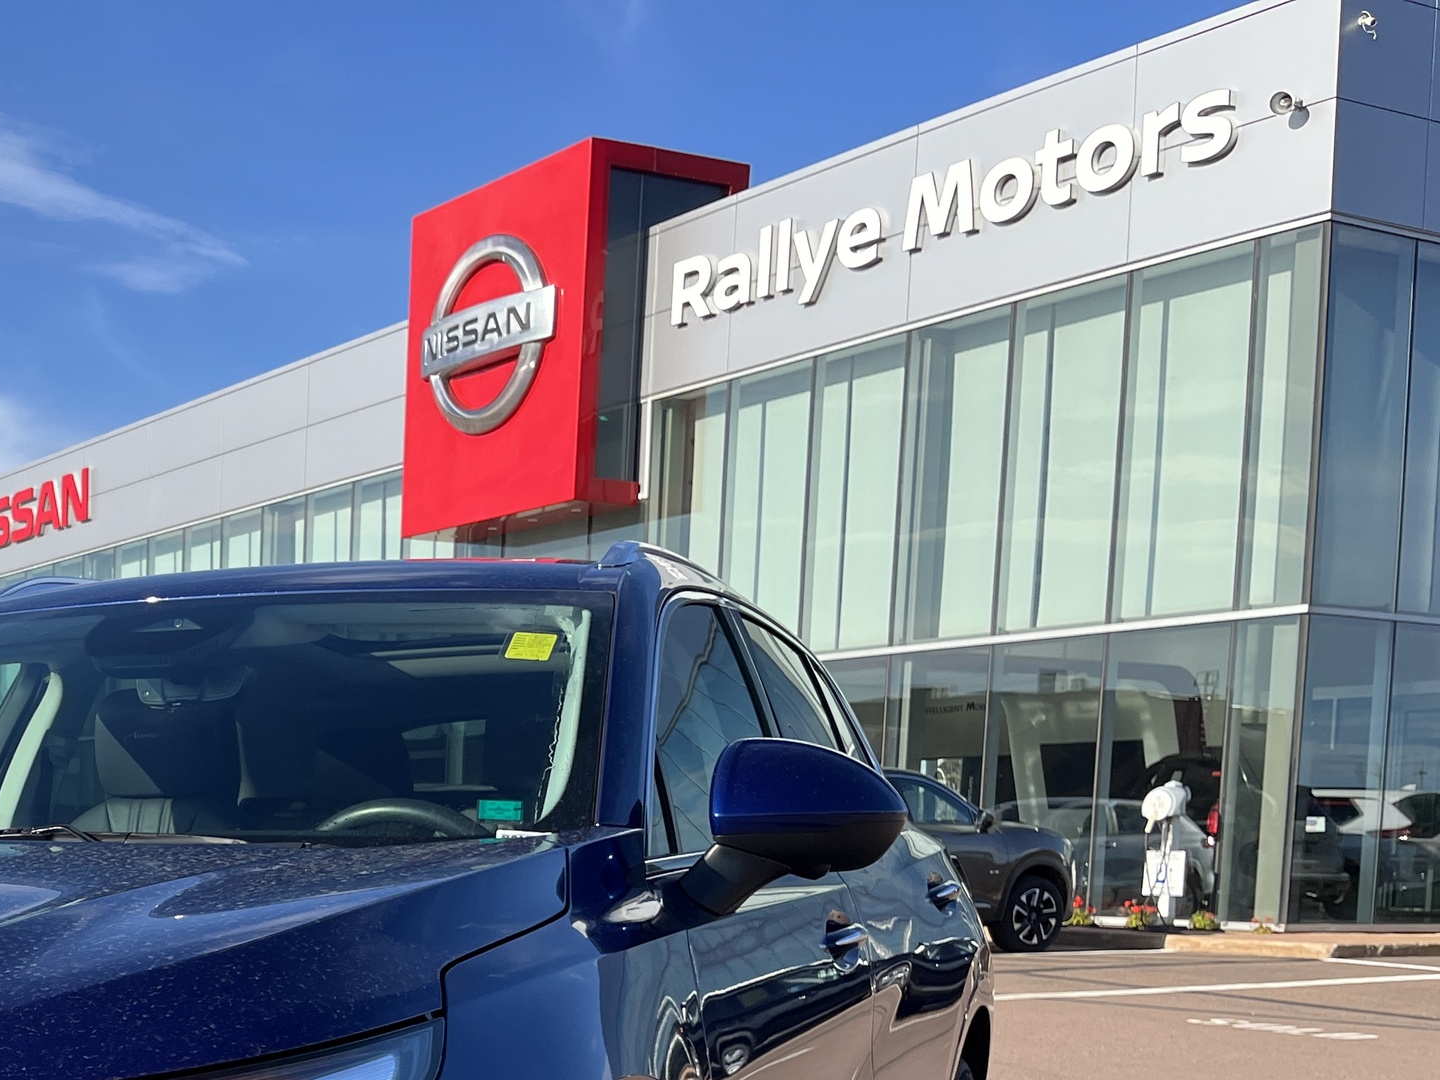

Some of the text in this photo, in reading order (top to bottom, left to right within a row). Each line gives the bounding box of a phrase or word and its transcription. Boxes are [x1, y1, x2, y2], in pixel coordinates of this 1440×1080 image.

[671, 88, 1238, 327] Rallye Motors
[423, 301, 532, 367] NISSAN
